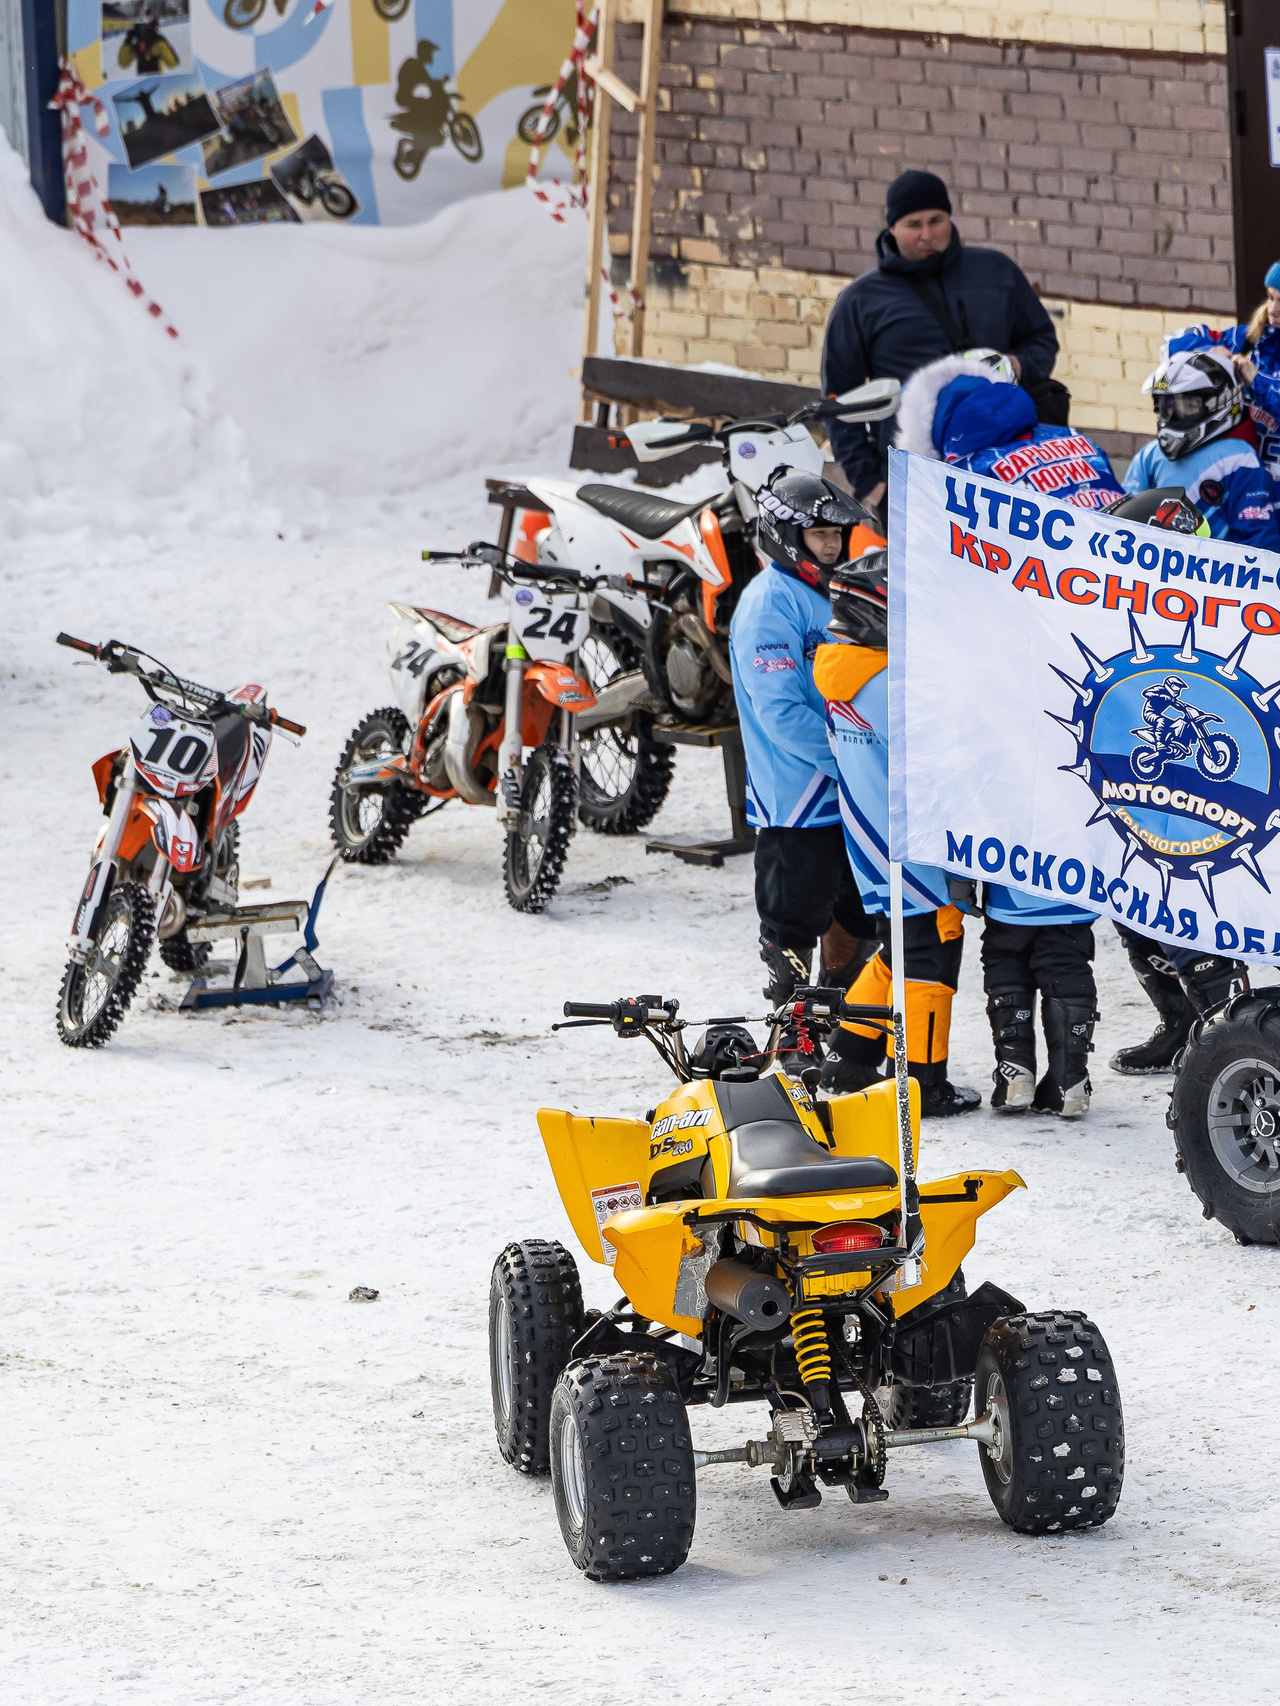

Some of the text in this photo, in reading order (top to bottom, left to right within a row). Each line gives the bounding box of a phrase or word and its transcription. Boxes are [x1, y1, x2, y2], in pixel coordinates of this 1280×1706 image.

[992, 435, 1097, 484] БАРЫБИН
[1027, 457, 1100, 494] ЮРИЙ
[756, 487, 815, 528] 100%
[945, 476, 1076, 551] ЦТВС
[523, 607, 577, 645] 24
[391, 640, 437, 679] 24
[144, 727, 208, 774] 10
[1102, 780, 1257, 839] МОТОСПОРТ
[1115, 806, 1224, 854] КРАСНОГОРСК
[946, 830, 1199, 940] МОСКОВСКАЯ
[781, 948, 810, 980] TCX
[1195, 959, 1214, 972] GTX
[1000, 1061, 1026, 1080] FOX
[650, 1107, 714, 1141] can-am
